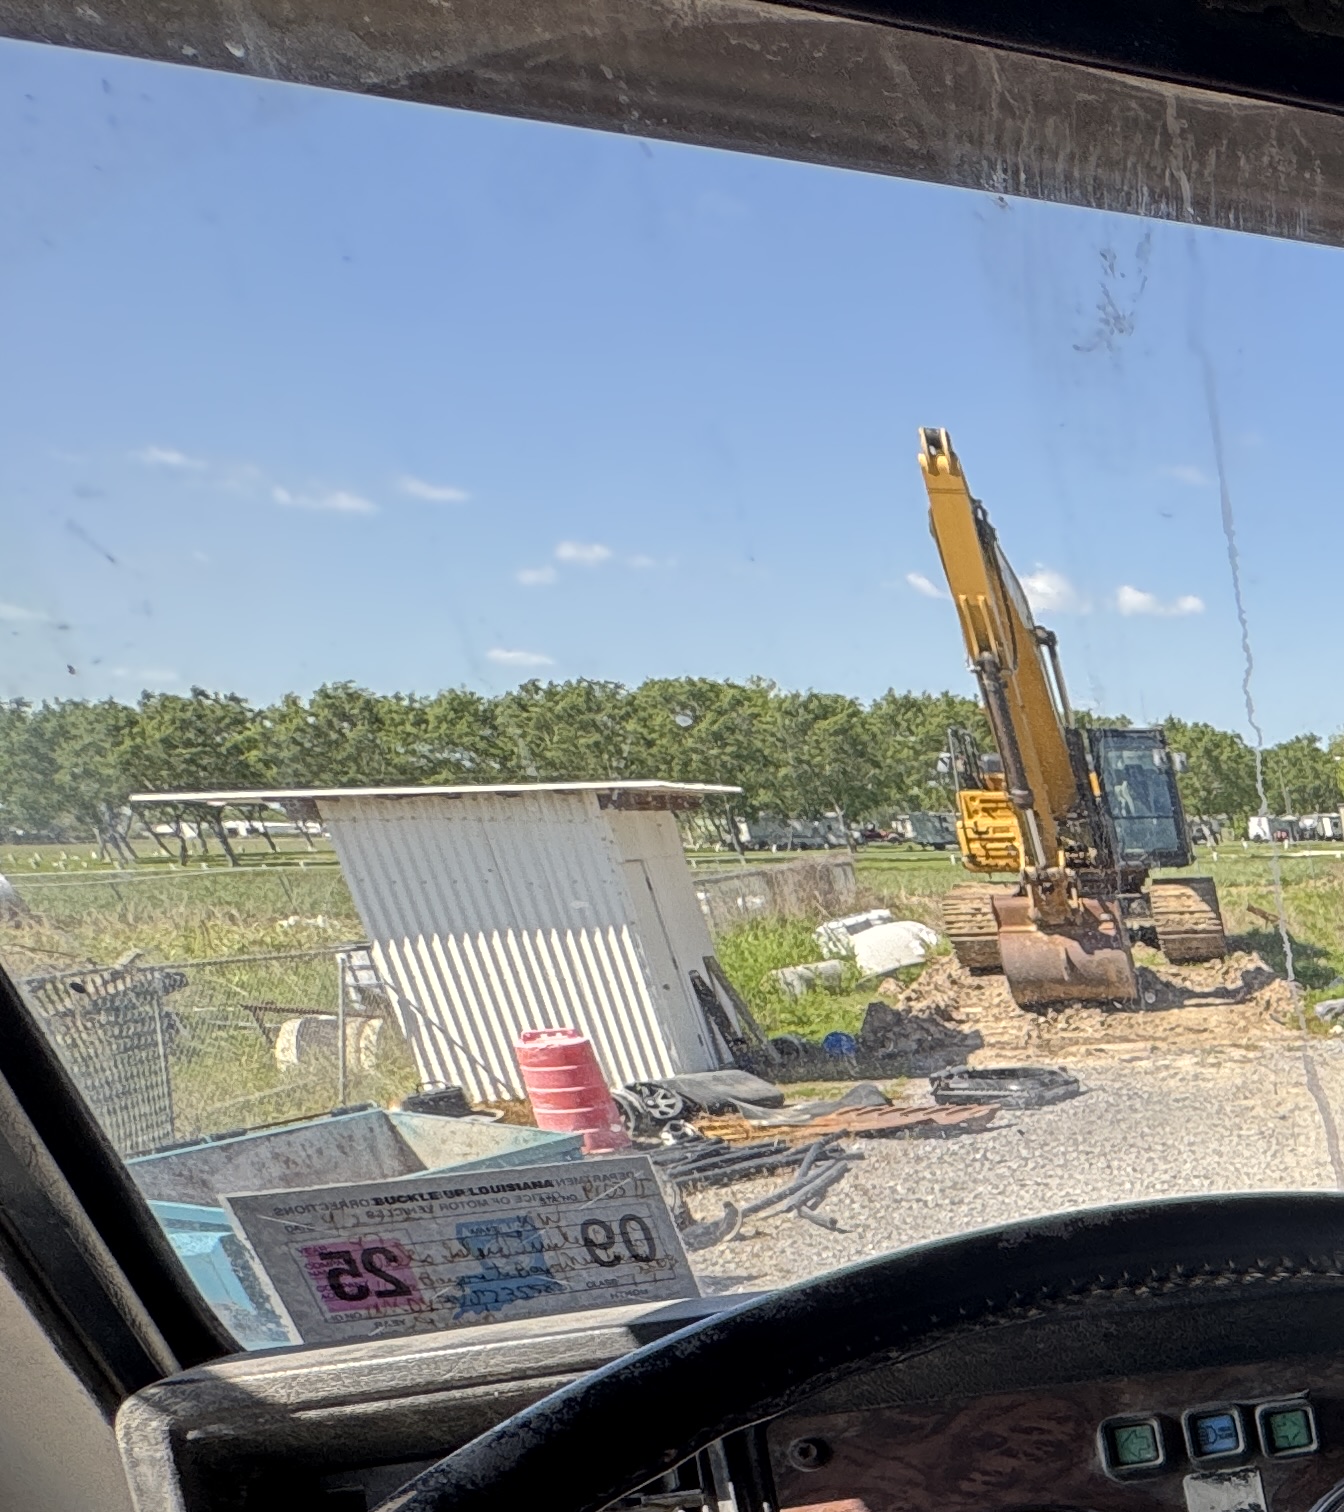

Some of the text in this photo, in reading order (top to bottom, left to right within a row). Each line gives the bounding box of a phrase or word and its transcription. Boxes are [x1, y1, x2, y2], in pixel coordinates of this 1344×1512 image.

[373, 1179, 554, 1206] BUCKLE UP LOUISIANA
